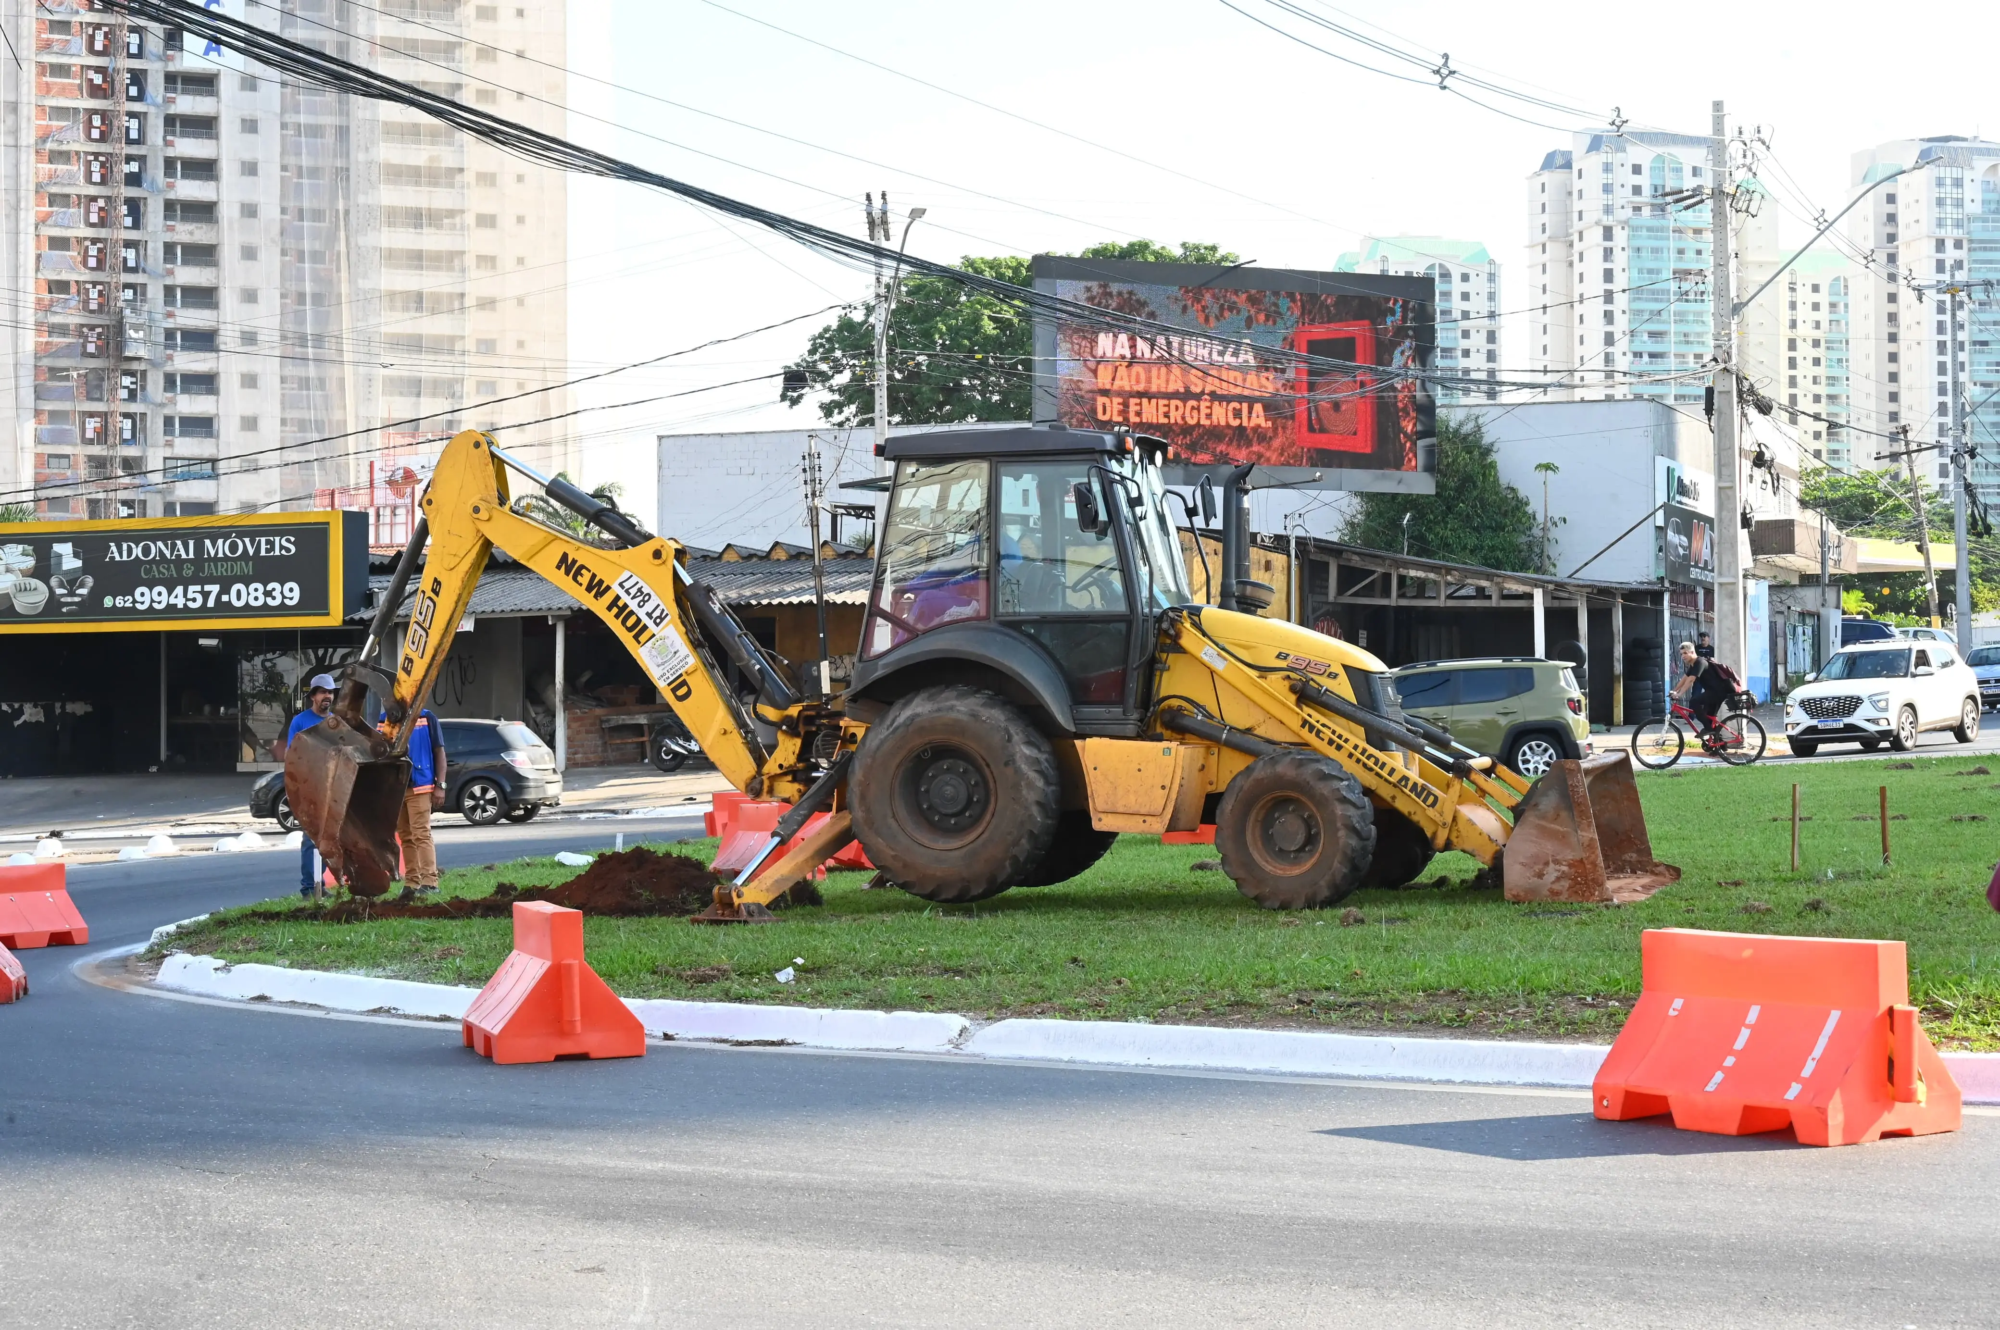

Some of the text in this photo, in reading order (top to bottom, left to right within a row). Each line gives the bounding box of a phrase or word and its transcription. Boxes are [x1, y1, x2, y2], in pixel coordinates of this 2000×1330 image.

[1097, 332, 1255, 364] NA NATUREZA
[1097, 361, 1145, 391] NÃO
[1189, 365, 1275, 397] SAÍDAS
[1096, 394, 1273, 428] DE EMERGÊNCIA.
[105, 533, 296, 561] ADONAI MÓVEIS
[1690, 519, 1714, 570] MA
[141, 561, 253, 579] CASA & JARDIM
[134, 581, 300, 610] 99457-0839
[618, 574, 652, 609] 8477
[555, 551, 693, 702] NEW HOLD
[645, 603, 669, 628] RT
[657, 672, 667, 681] USO
[667, 653, 690, 673] EXCLUSIVO
[670, 661, 689, 677] SERVIÇO
[1300, 713, 1439, 809] NEW HOLLAND
